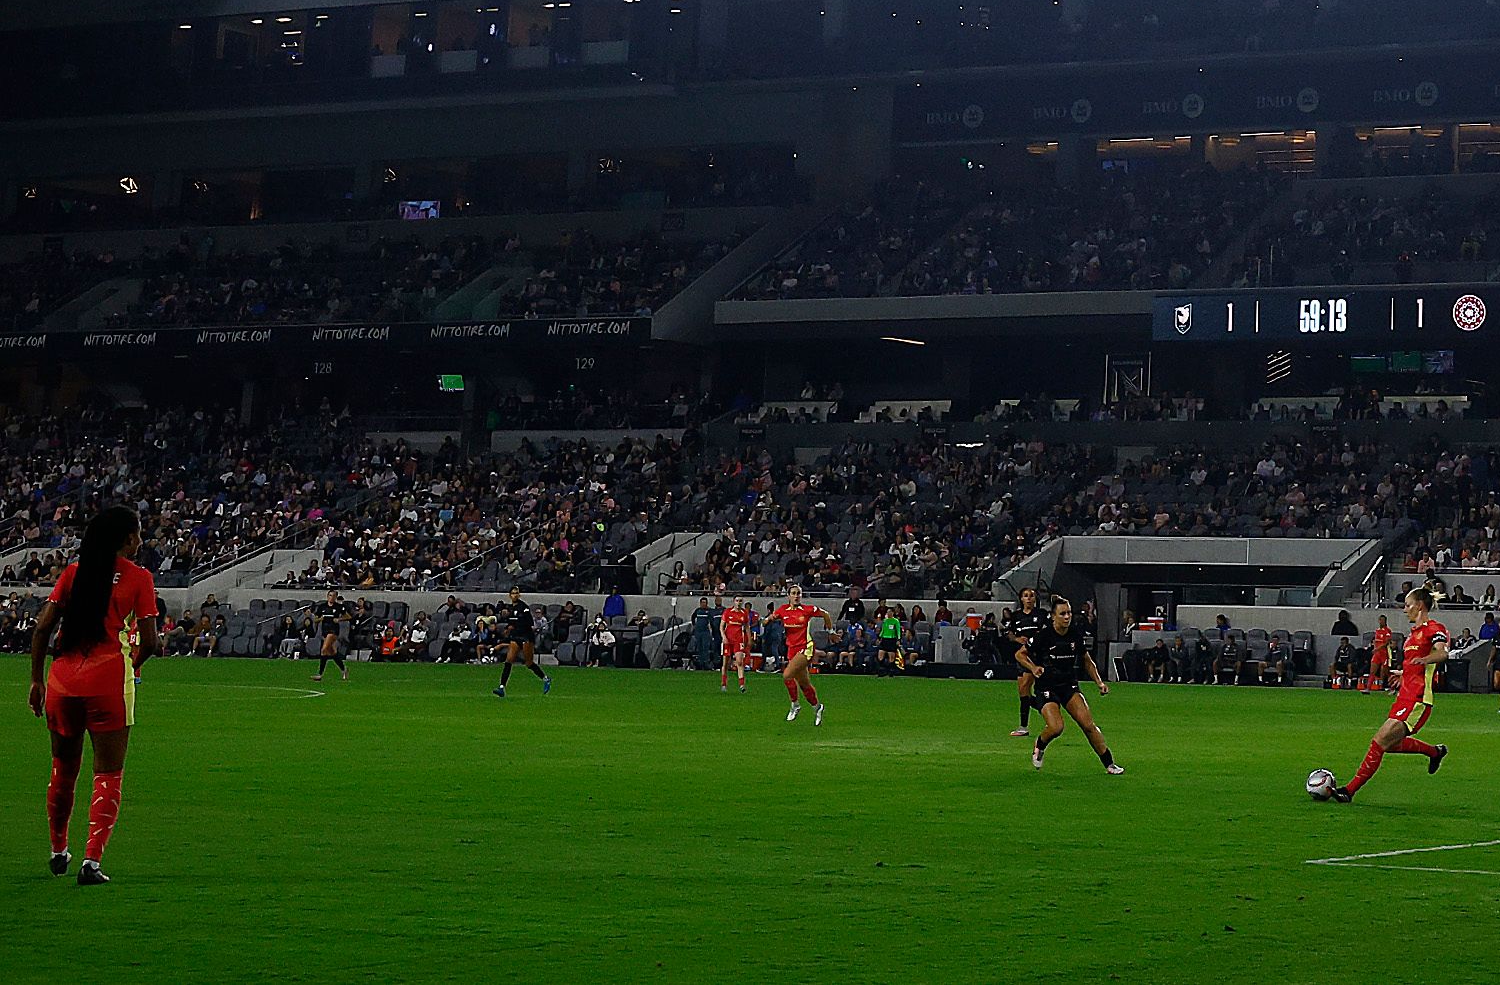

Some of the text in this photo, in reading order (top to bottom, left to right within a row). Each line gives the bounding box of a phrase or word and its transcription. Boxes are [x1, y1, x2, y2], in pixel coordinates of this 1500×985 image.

[1227, 302, 1233, 332] 1
[1300, 299, 1347, 333] 59:13
[1417, 298, 1423, 328] 1
[312, 326, 389, 341] NITTOTIRE.COM
[431, 322, 509, 338] NITTOTIRE.COM
[547, 320, 631, 336] NITTOTIRE.COM
[84, 332, 157, 346] NITTOTIRE.COM
[197, 329, 271, 343] NITTOTIRE.COM
[314, 362, 332, 374] 128
[575, 357, 595, 370] 129
